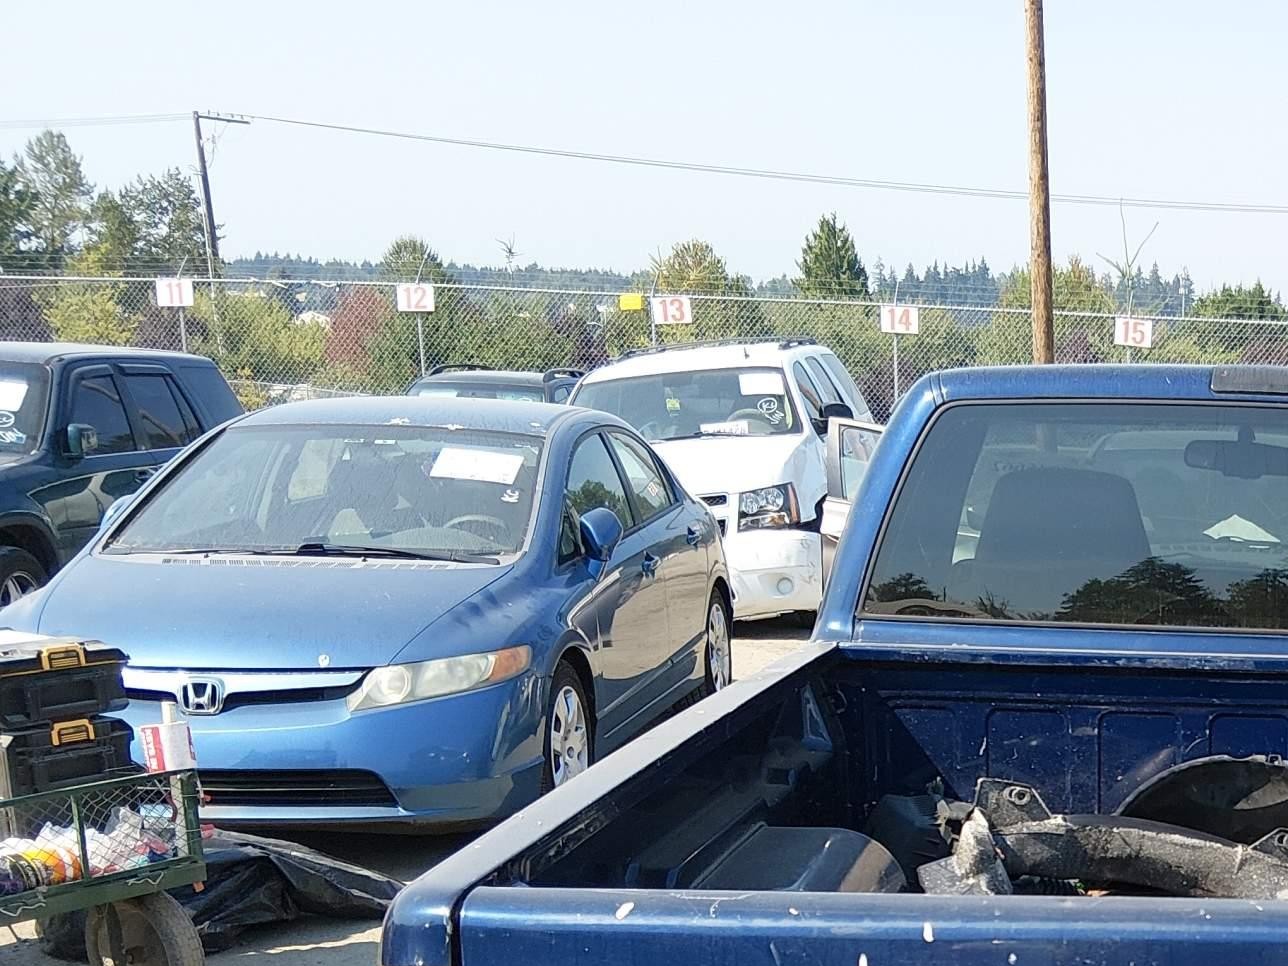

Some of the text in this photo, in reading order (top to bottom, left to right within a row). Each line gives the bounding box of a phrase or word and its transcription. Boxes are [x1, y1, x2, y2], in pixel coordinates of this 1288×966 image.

[165, 282, 184, 305] 11
[403, 286, 427, 309] 12
[659, 298, 685, 321] 13
[887, 308, 912, 331] 14
[1122, 320, 1145, 344] 15
